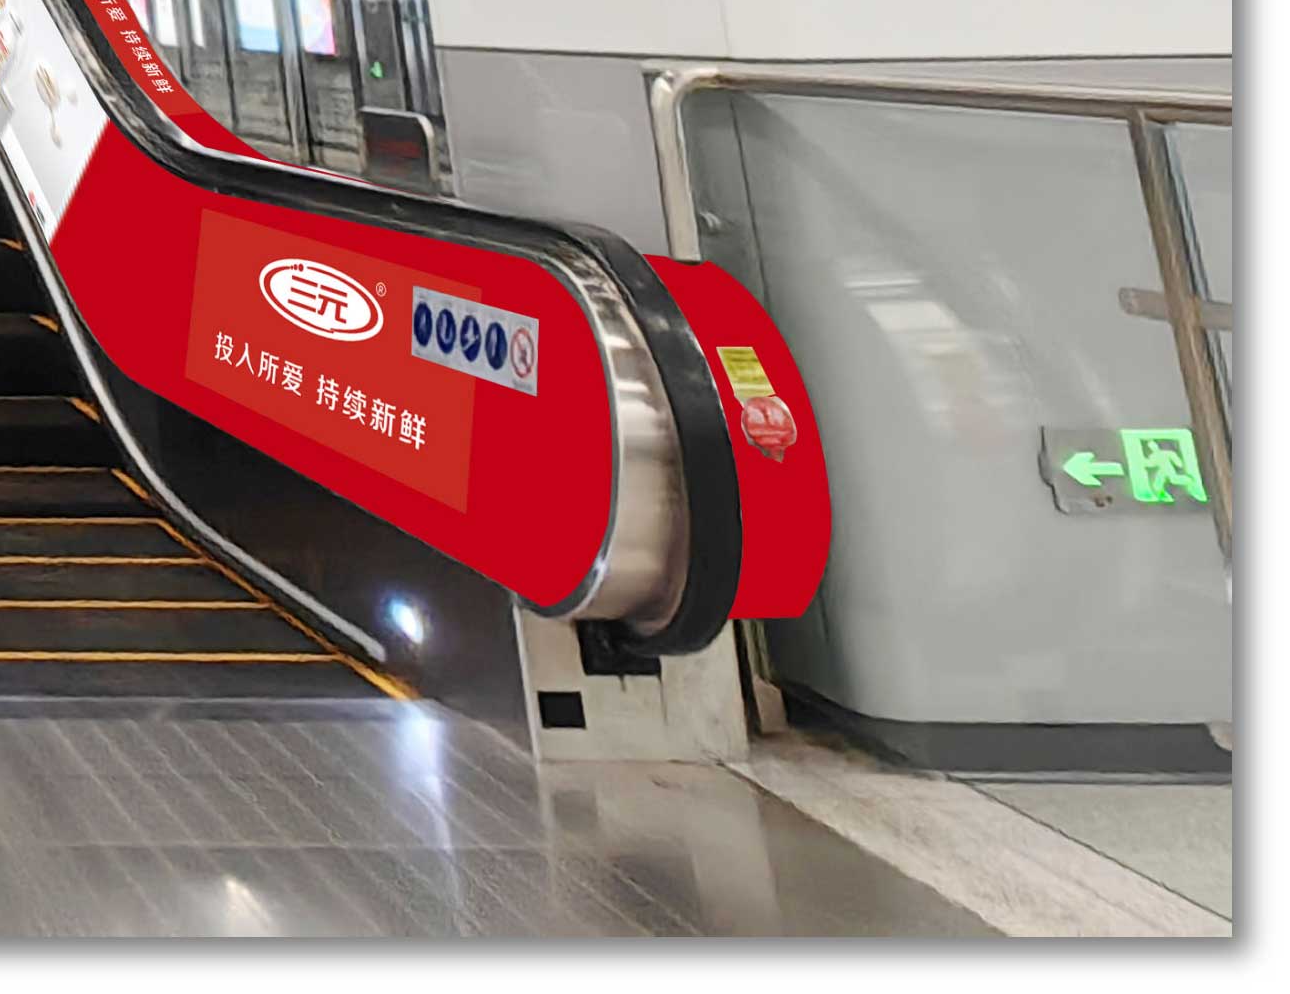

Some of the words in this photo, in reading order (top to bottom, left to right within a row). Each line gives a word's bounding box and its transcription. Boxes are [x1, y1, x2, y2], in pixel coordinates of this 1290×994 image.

[215, 332, 304, 397] 投人所爱
[316, 374, 427, 451] 持续新鲜
